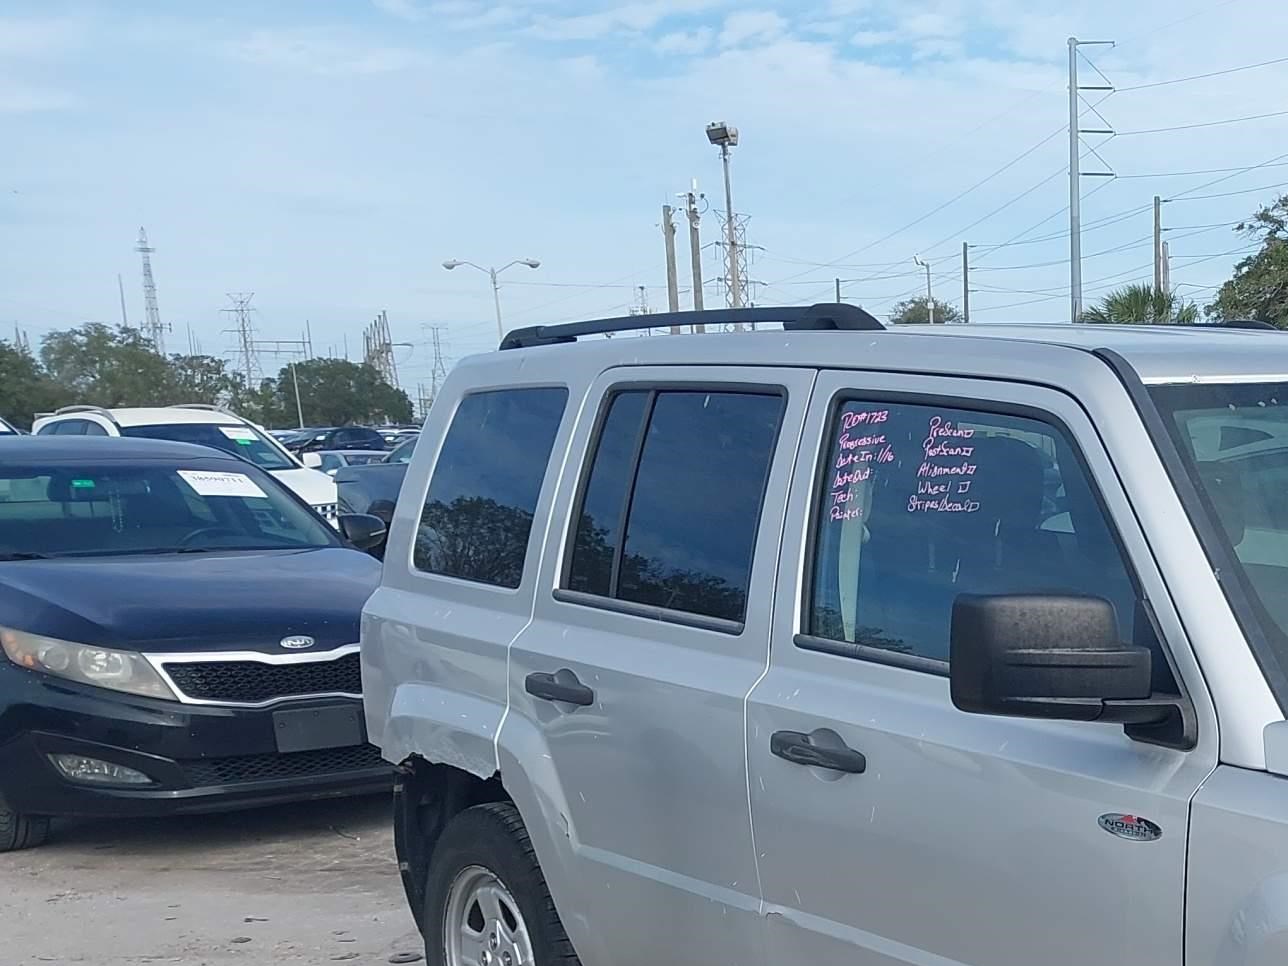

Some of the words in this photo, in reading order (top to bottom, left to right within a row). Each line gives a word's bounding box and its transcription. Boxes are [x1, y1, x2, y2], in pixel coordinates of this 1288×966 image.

[917, 462, 968, 478] Alignment
[918, 481, 952, 495] Wheel
[1104, 819, 1154, 834] NORTH
